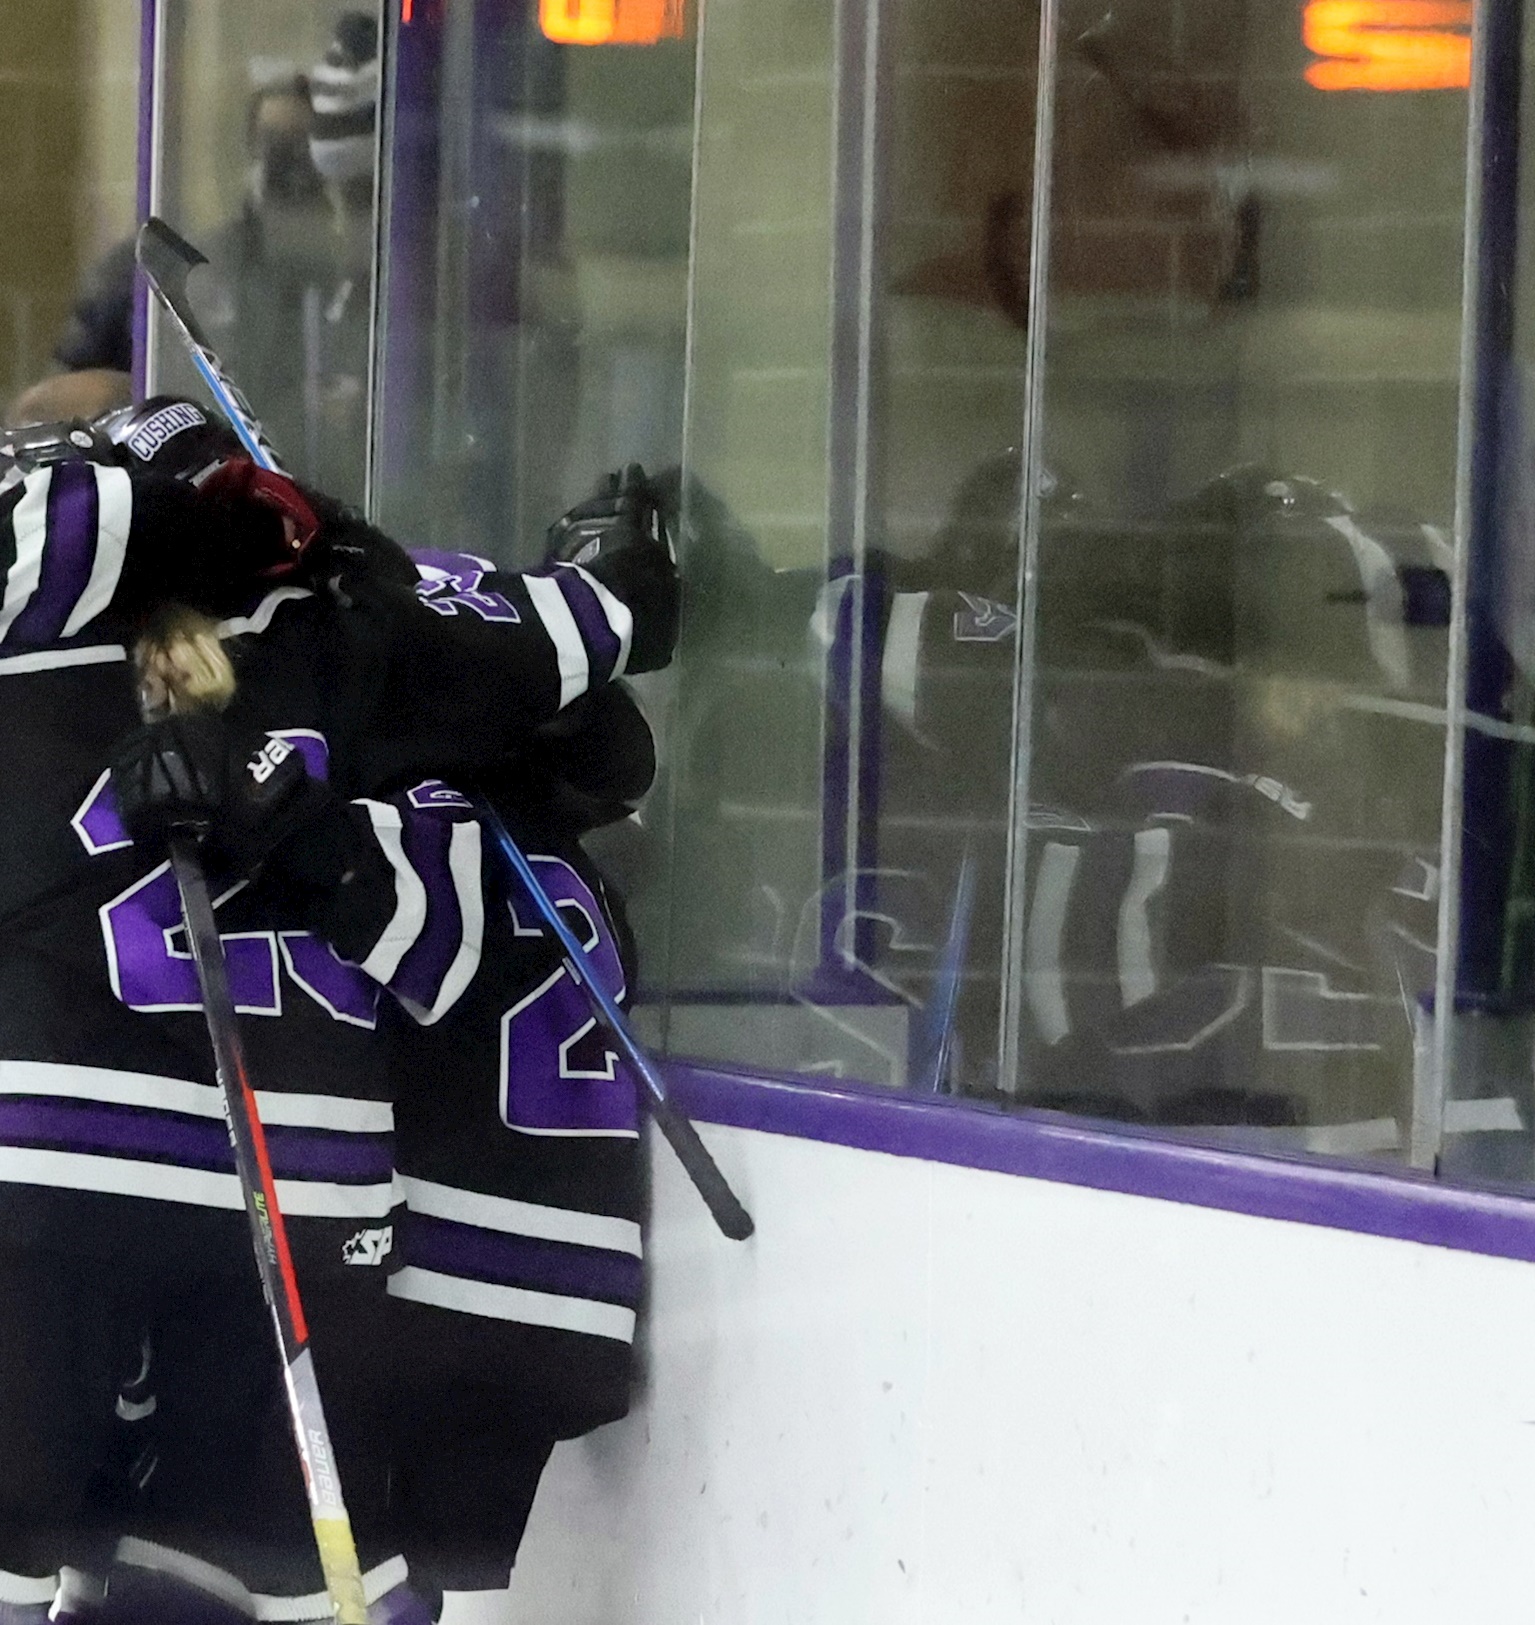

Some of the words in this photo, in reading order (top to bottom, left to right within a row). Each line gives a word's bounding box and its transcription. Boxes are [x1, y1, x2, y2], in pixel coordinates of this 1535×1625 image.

[128, 402, 207, 461] CUSHING
[246, 738, 295, 783] ER
[307, 1428, 338, 1507] BAUER
